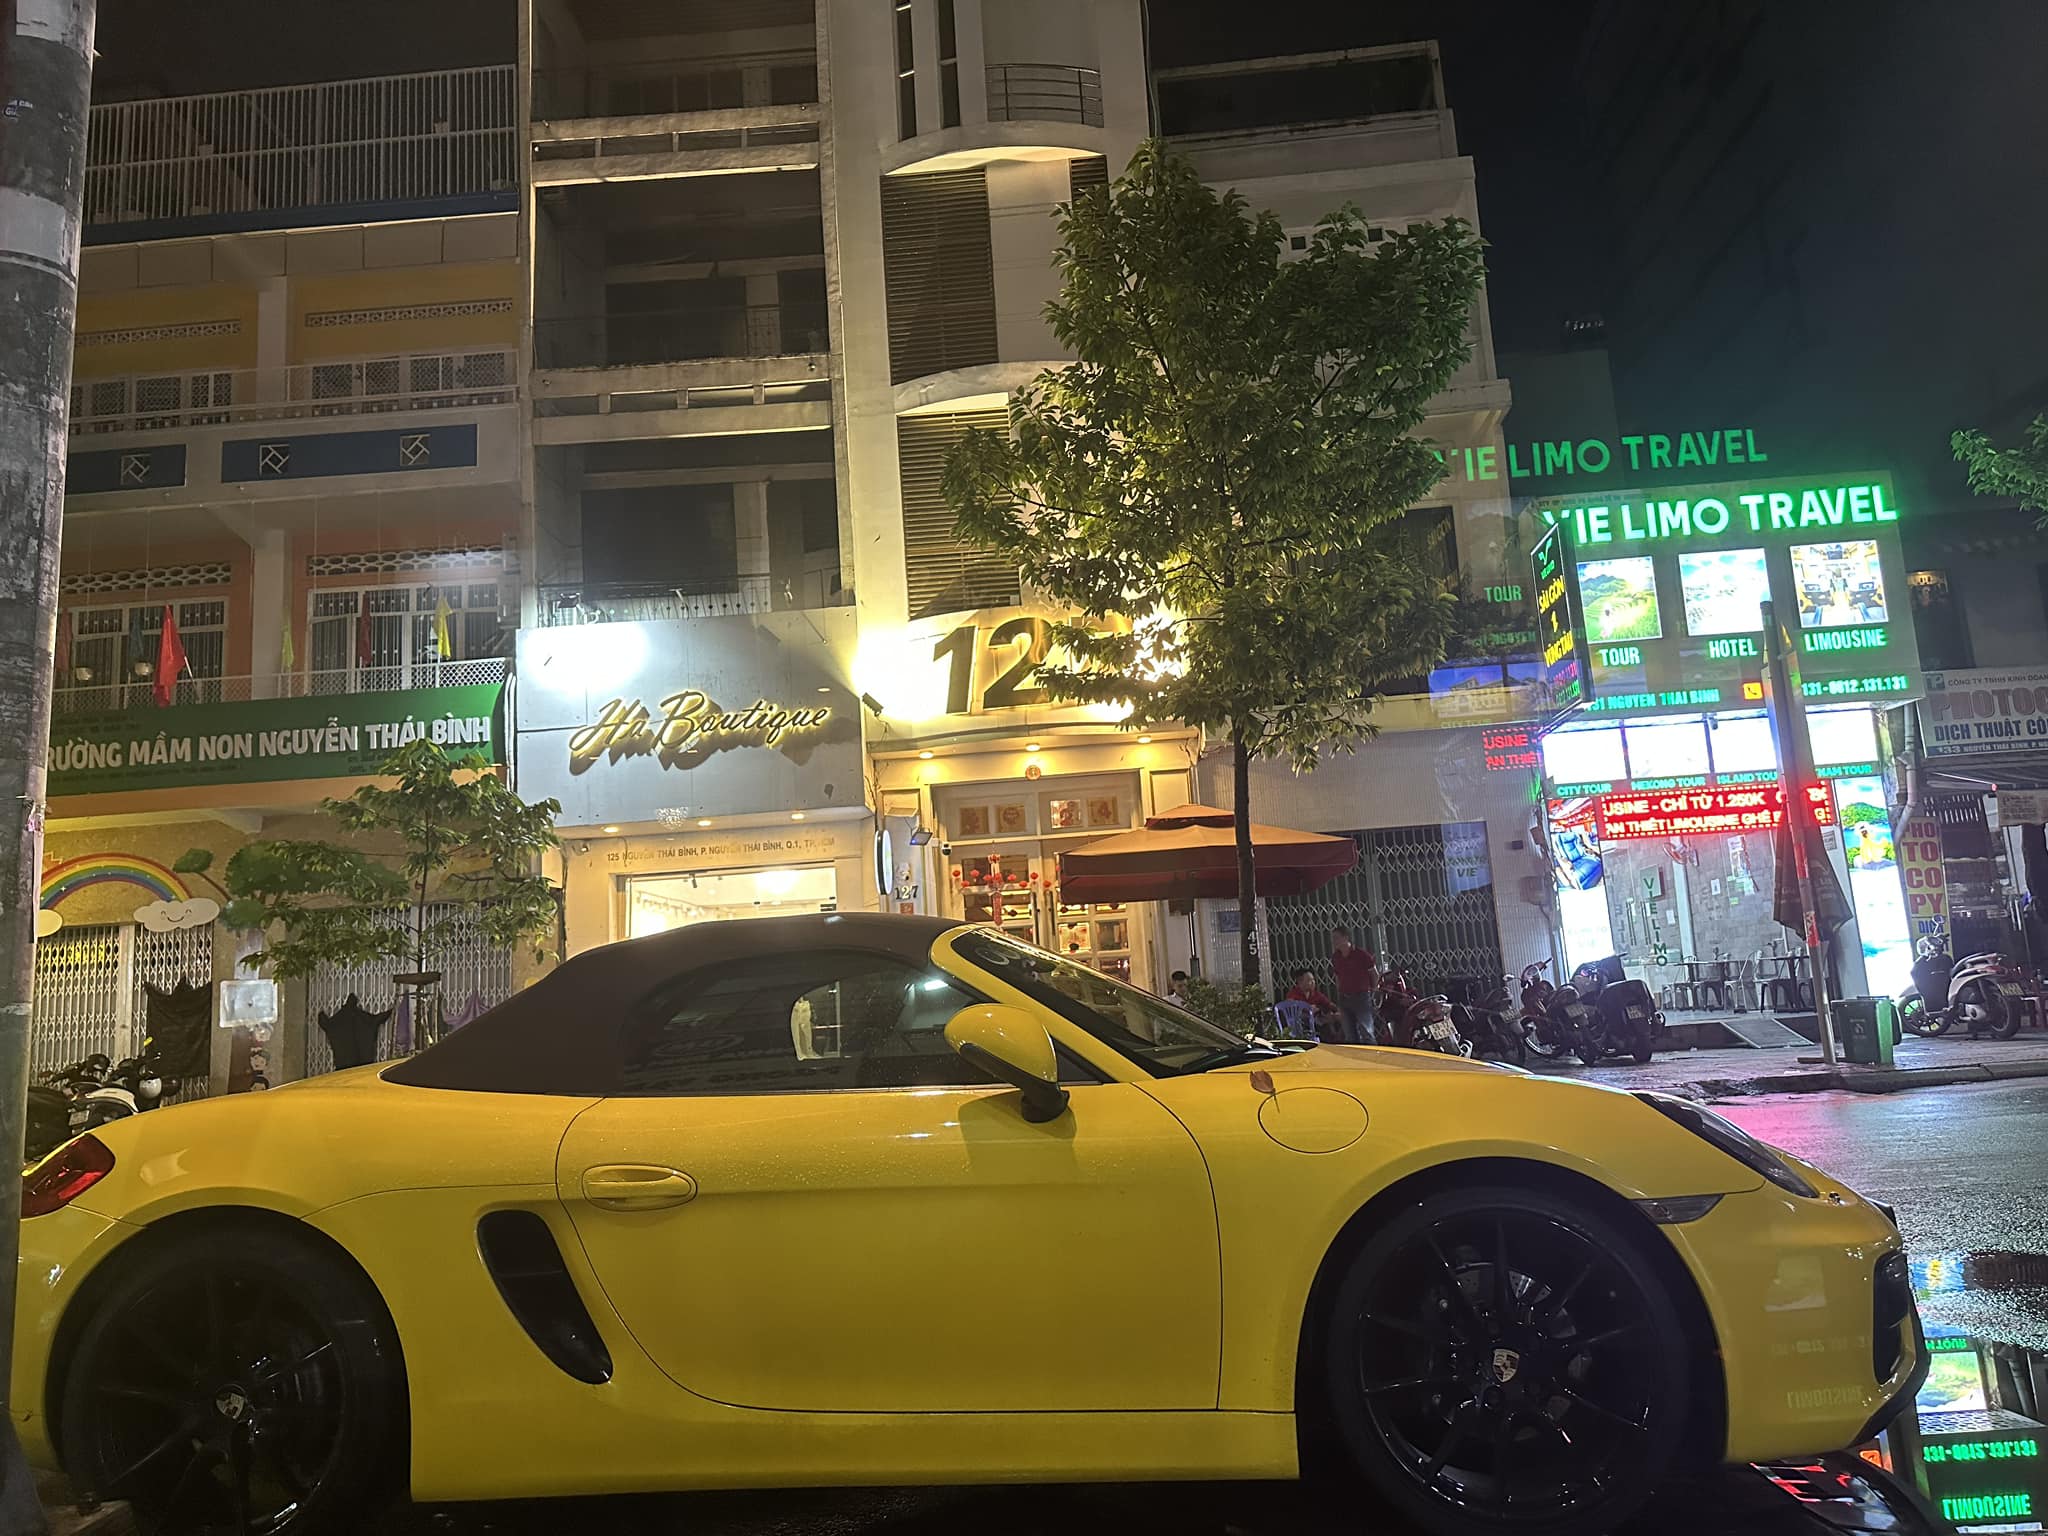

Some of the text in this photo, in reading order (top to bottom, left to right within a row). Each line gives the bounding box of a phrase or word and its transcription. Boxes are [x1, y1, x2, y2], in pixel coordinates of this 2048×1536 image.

[1507, 438, 1611, 479] LIMO
[1621, 428, 1768, 471] TRAVEL
[1620, 498, 1730, 541] LIMO
[1739, 485, 1899, 532] TRAVEL
[1484, 584, 1522, 603] TOUR
[1708, 637, 1758, 659] HOTEL
[1804, 628, 1887, 652] LIMOUSINE
[933, 616, 1133, 714] 12
[1599, 646, 1641, 667] TOUR
[653, 689, 830, 746] Boutique
[1934, 715, 2048, 744] DỊCH THUẬT CÔ
[47, 737, 123, 772] RƯỜNG
[128, 730, 192, 766] MẦM
[198, 733, 253, 762] NON
[259, 717, 358, 757] NGUYỄN
[431, 713, 491, 745] BÌNH
[1937, 744, 1961, 754] 133
[1716, 770, 1778, 785] ISLAND TOU
[1843, 764, 1873, 776] TOUR
[1556, 783, 1612, 796] CITY TOUR
[1631, 776, 1706, 791] MEKONG TOUR
[607, 853, 620, 862] 125
[657, 847, 676, 858] THÁI
[678, 845, 699, 857] BÌNH,
[700, 846, 708, 856] P.
[743, 841, 761, 853] THÁI
[1902, 841, 1939, 862] TO
[1905, 867, 1943, 889] CO
[894, 884, 919, 900] 127
[1909, 893, 1944, 915] PY
